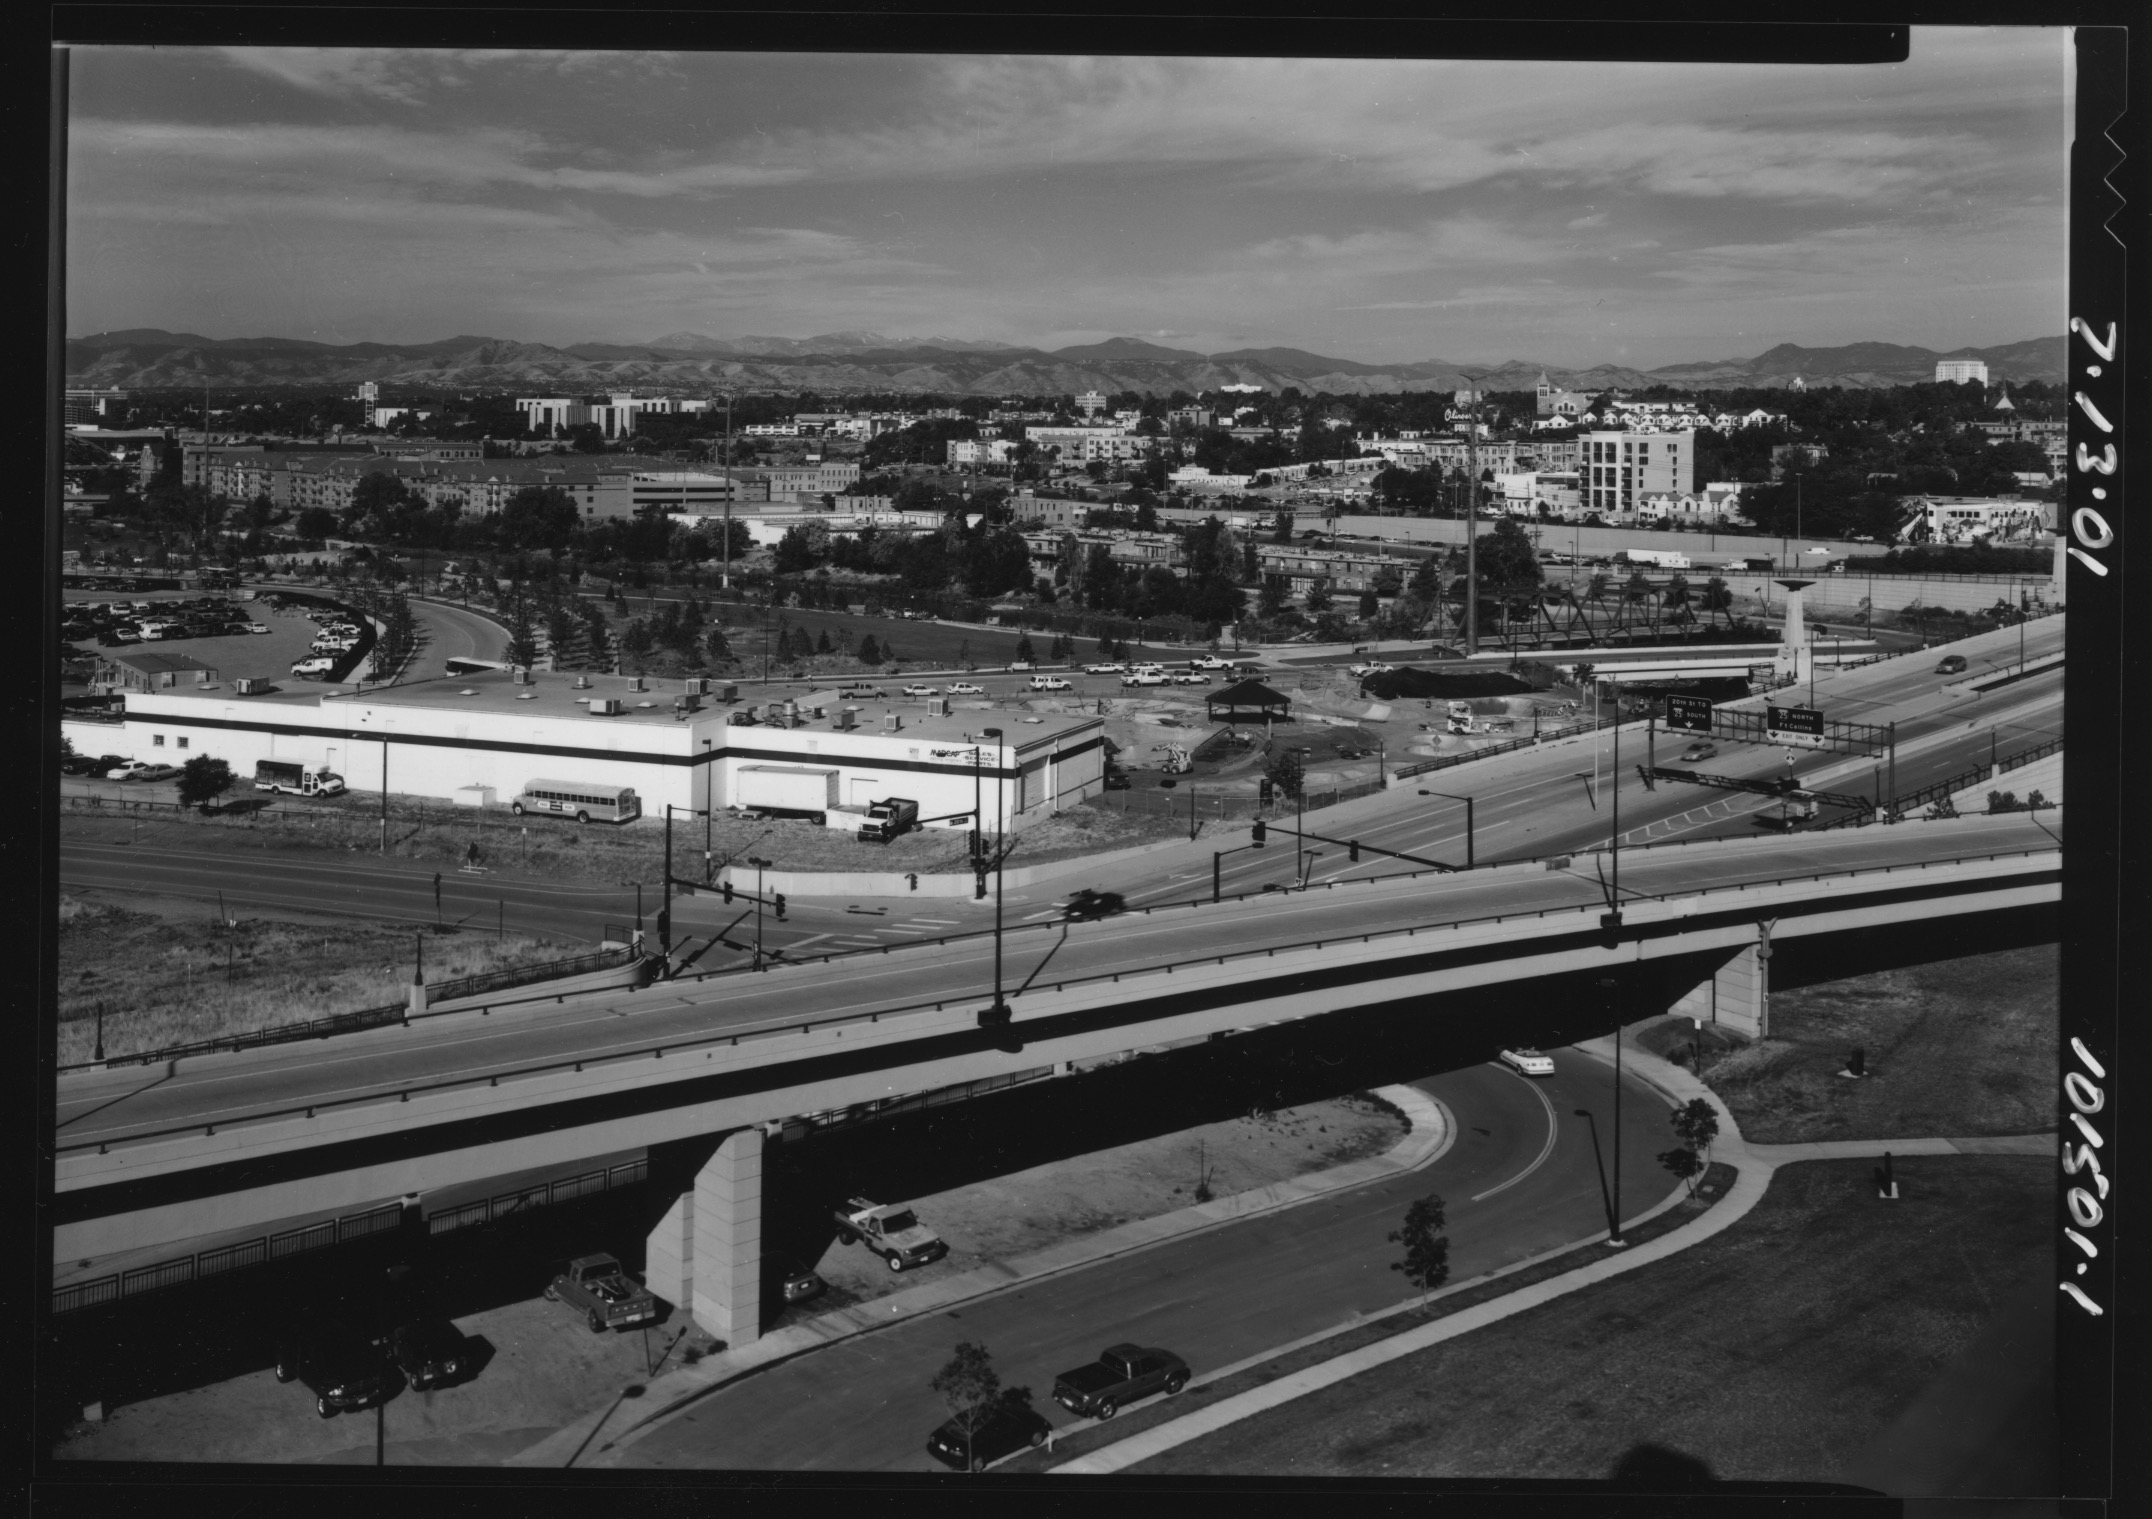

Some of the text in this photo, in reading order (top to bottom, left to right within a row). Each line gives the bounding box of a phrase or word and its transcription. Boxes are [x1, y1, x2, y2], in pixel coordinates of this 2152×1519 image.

[1672, 698, 1687, 706] 20th
[1674, 710, 1683, 718] 25
[1789, 723, 1813, 731] Collins
